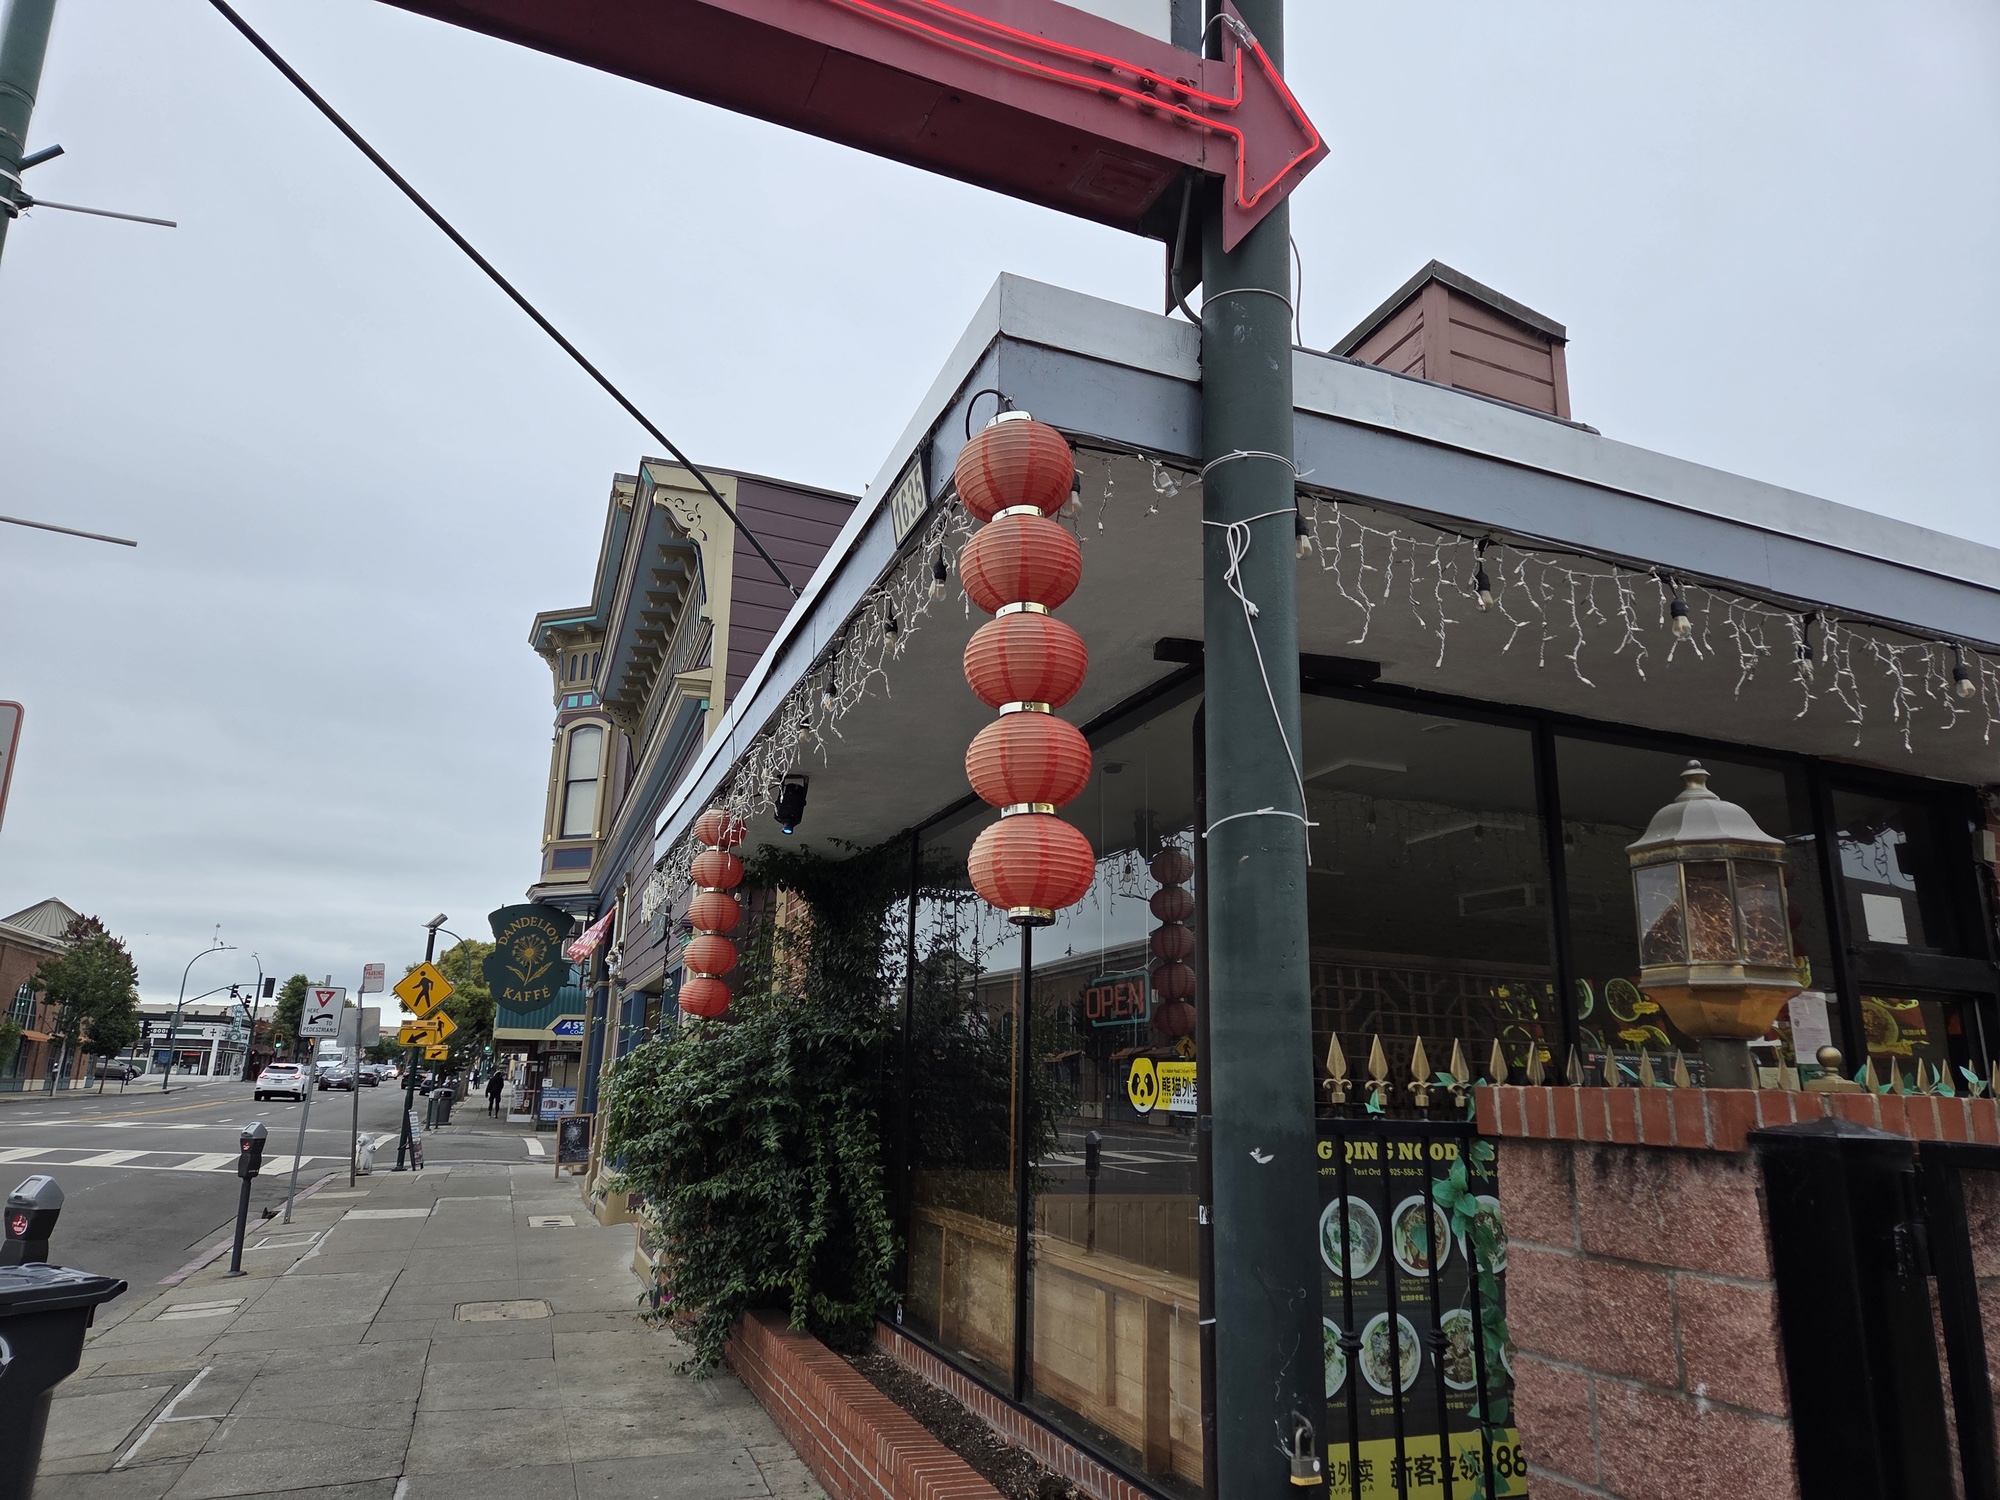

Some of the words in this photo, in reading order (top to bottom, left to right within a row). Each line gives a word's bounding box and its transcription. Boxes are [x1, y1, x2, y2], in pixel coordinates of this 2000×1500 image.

[894, 464, 924, 537] 1635
[498, 916, 561, 946] DANDELION
[503, 985, 551, 1002] KAFFÉ
[1086, 980, 1145, 1019] OPEN
[1353, 1167, 1368, 1176] Text
